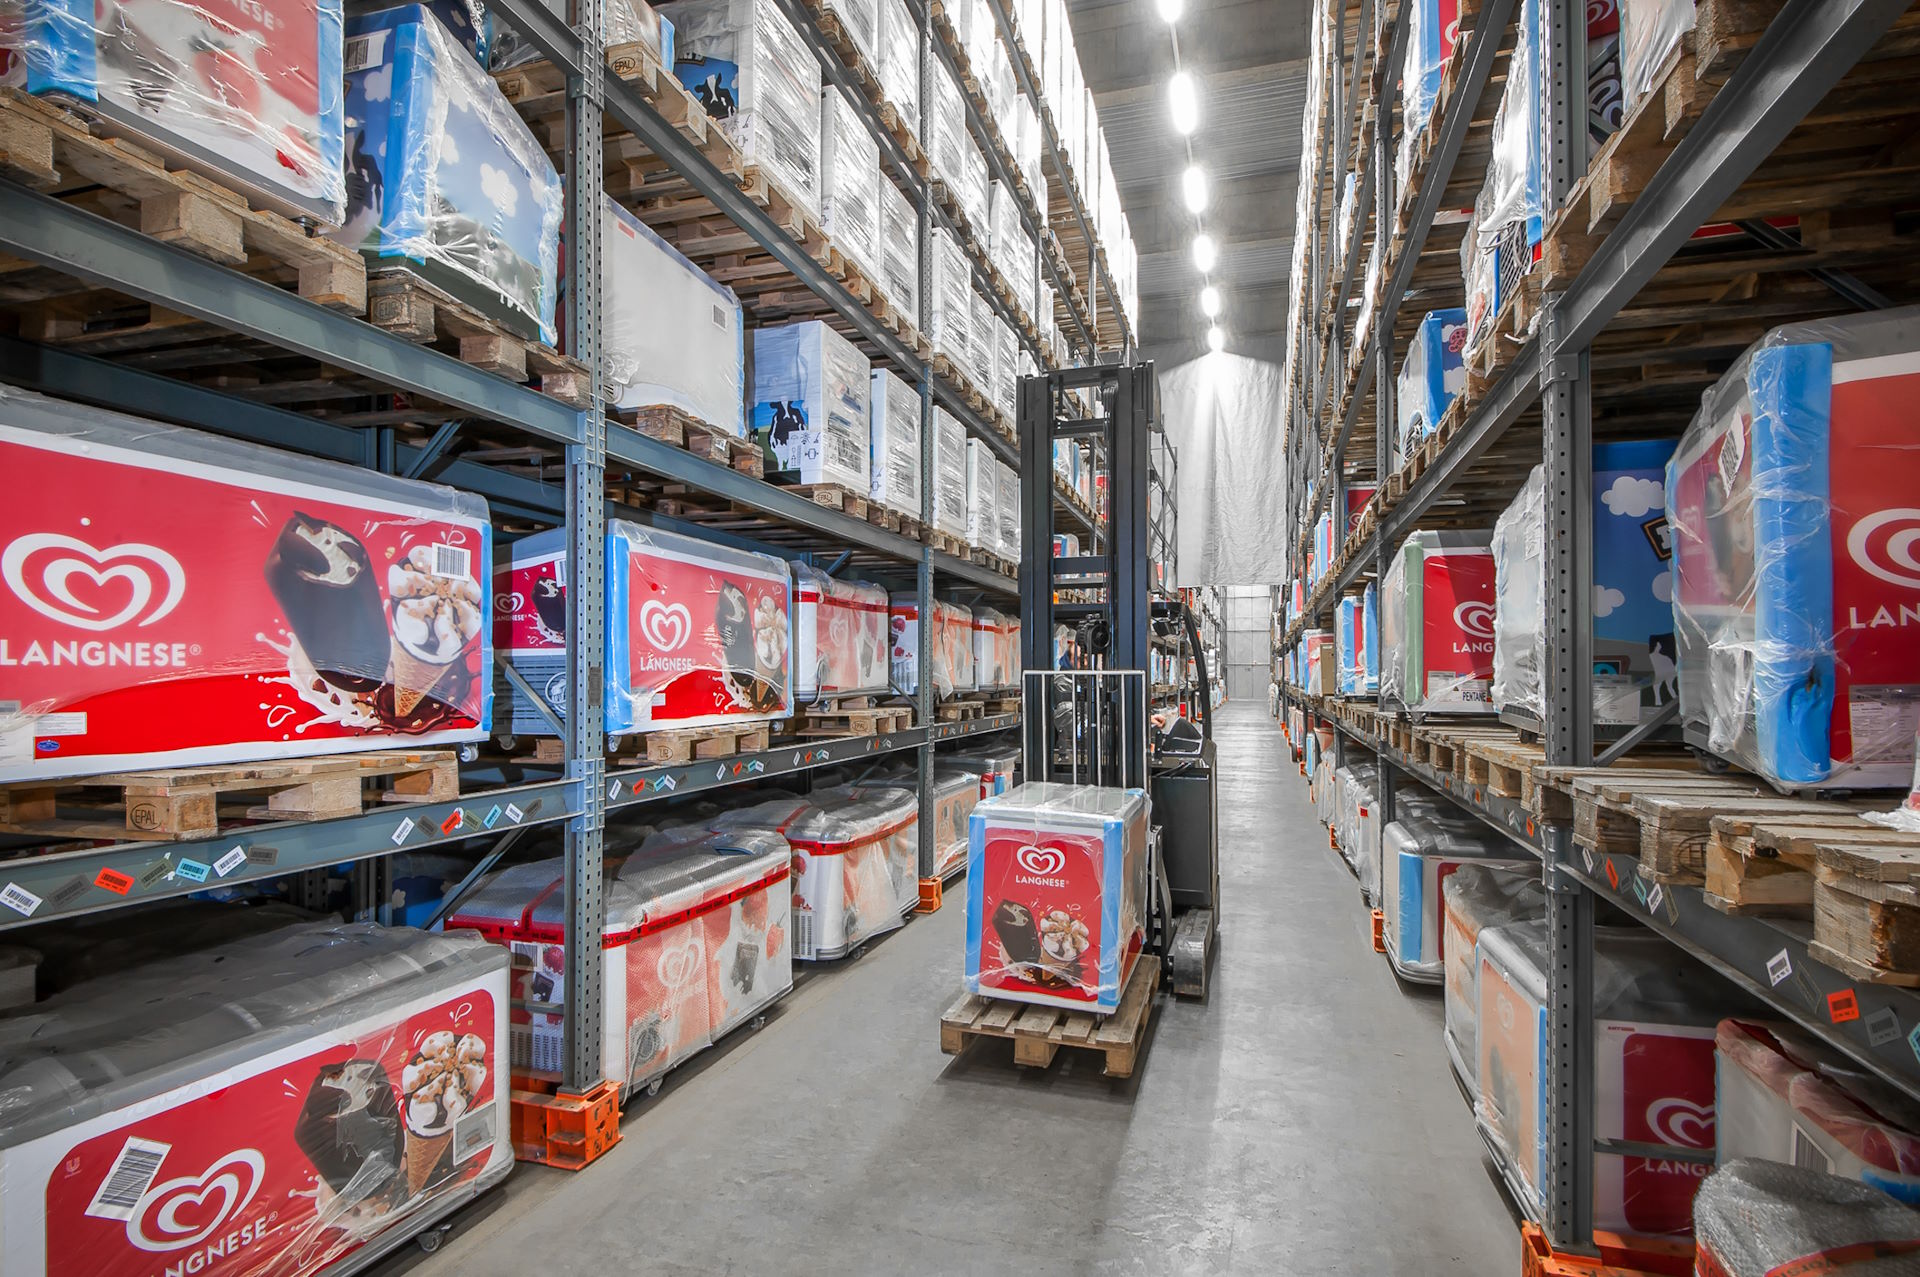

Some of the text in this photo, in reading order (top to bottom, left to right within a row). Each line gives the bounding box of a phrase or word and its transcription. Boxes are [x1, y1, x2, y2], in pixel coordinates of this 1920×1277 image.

[1462, 690, 1487, 703] PENTANE
[134, 808, 159, 824] EPAL
[1015, 874, 1065, 888] LANGNESE
